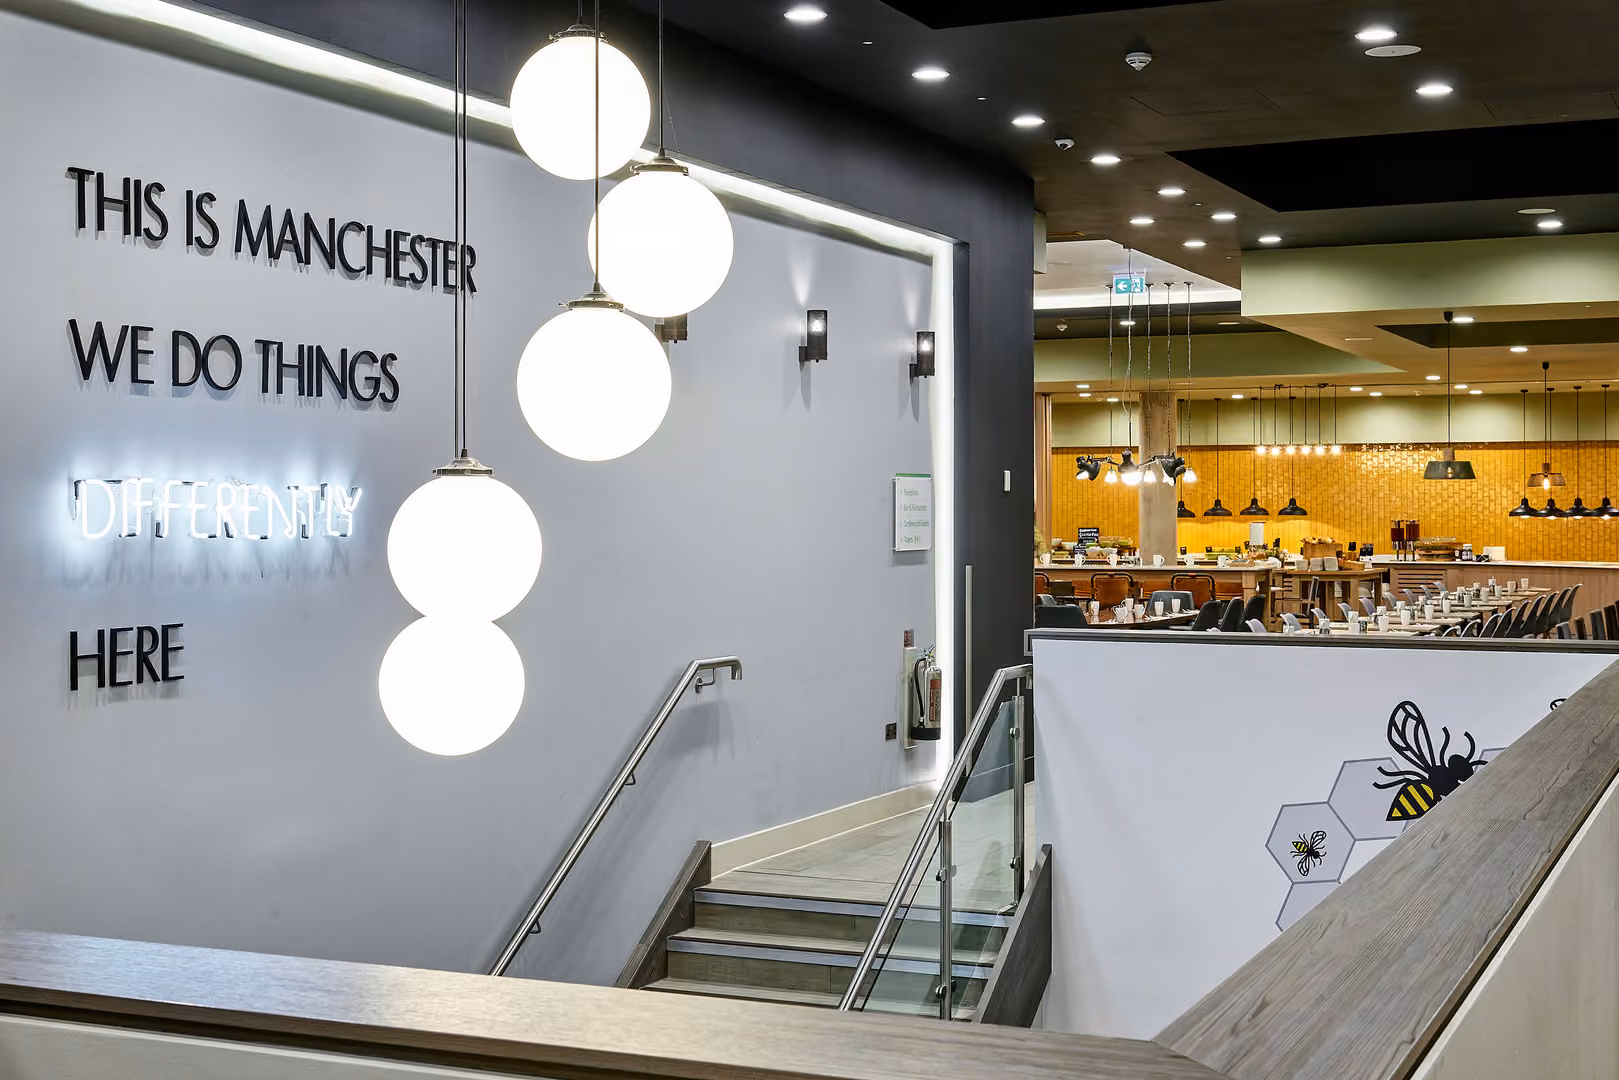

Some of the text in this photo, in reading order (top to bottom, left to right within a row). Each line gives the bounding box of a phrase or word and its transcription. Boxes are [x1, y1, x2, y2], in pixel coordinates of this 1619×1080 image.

[66, 166, 478, 293] THIS IS MANCHESTER
[68, 319, 400, 403] WE DO THINGS
[72, 477, 363, 540] DIFFERENTLY
[70, 623, 185, 691] HERE
